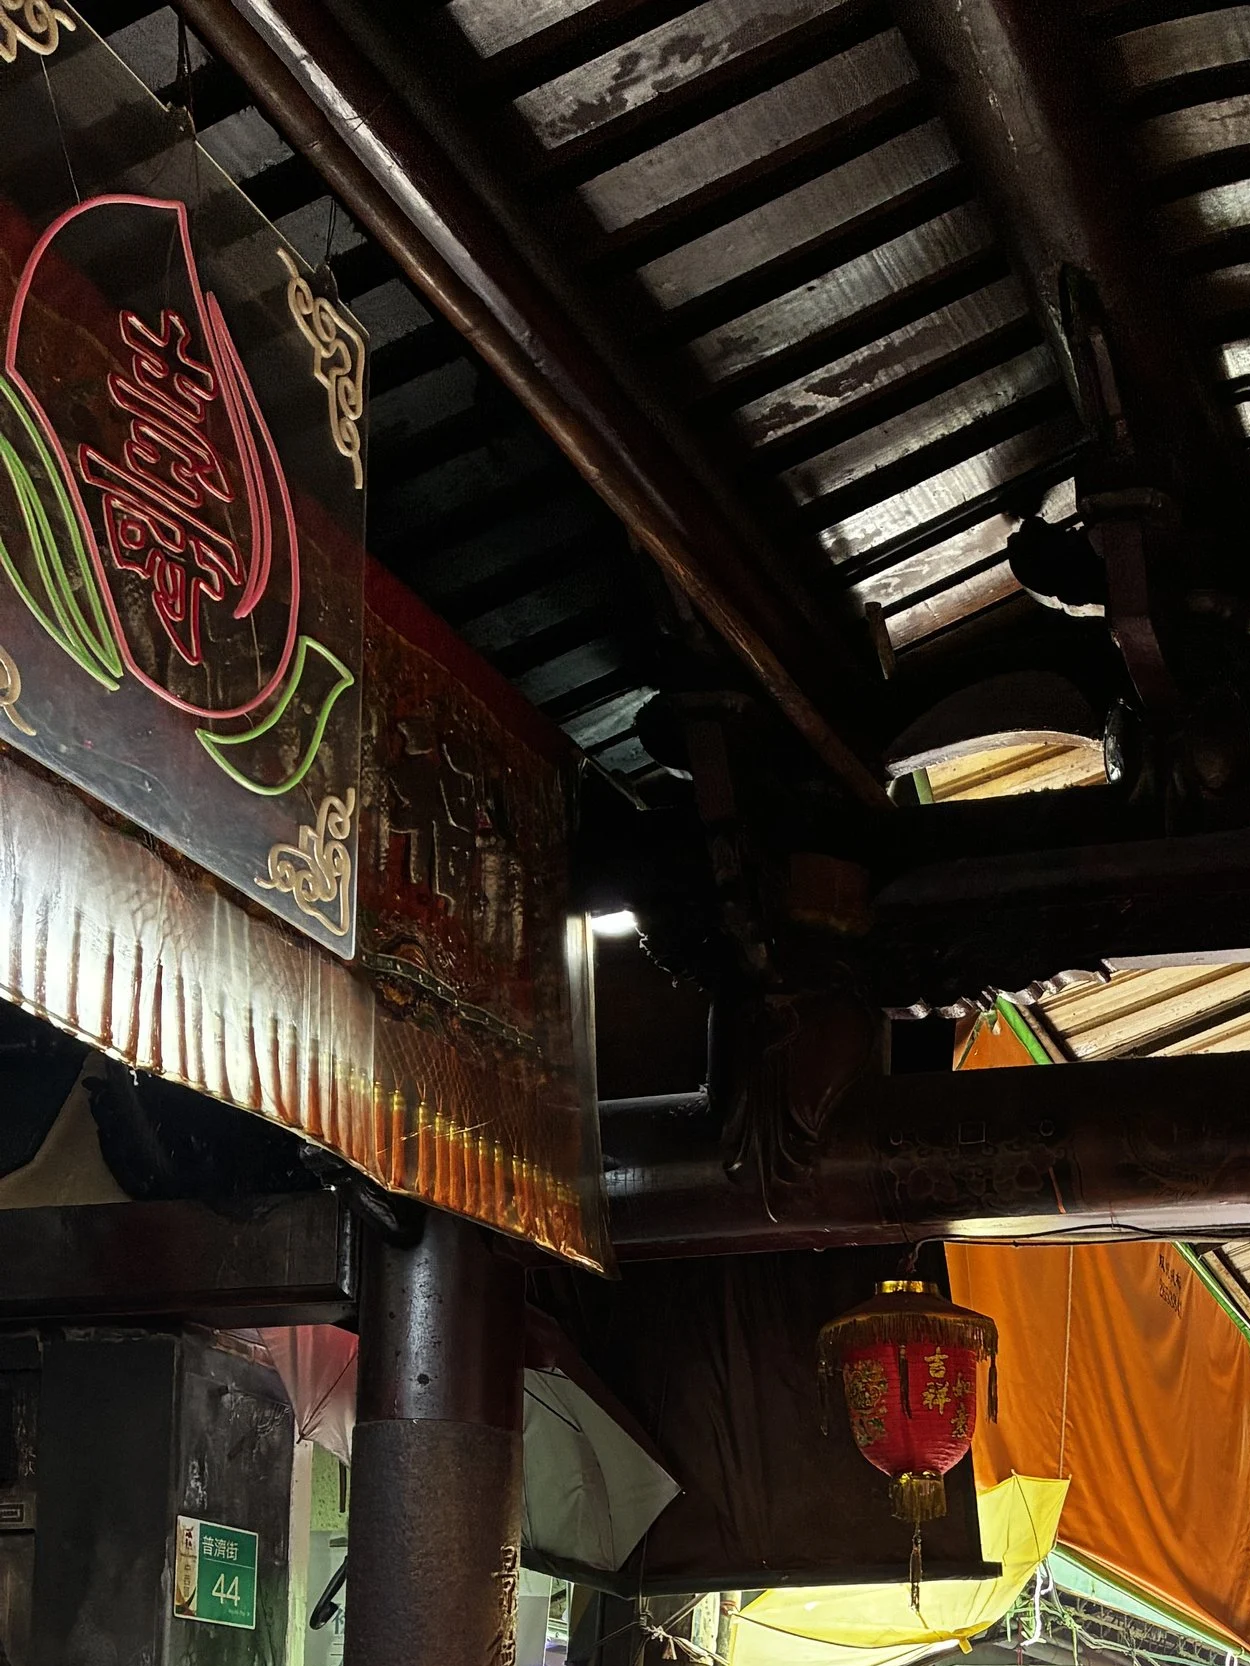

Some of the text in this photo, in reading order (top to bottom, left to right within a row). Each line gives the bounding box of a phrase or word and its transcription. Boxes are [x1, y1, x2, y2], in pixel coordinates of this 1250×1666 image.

[922, 1346, 951, 1415] 吉祥
[202, 1535, 239, 1561] 普濟街
[211, 1573, 240, 1607] 44
